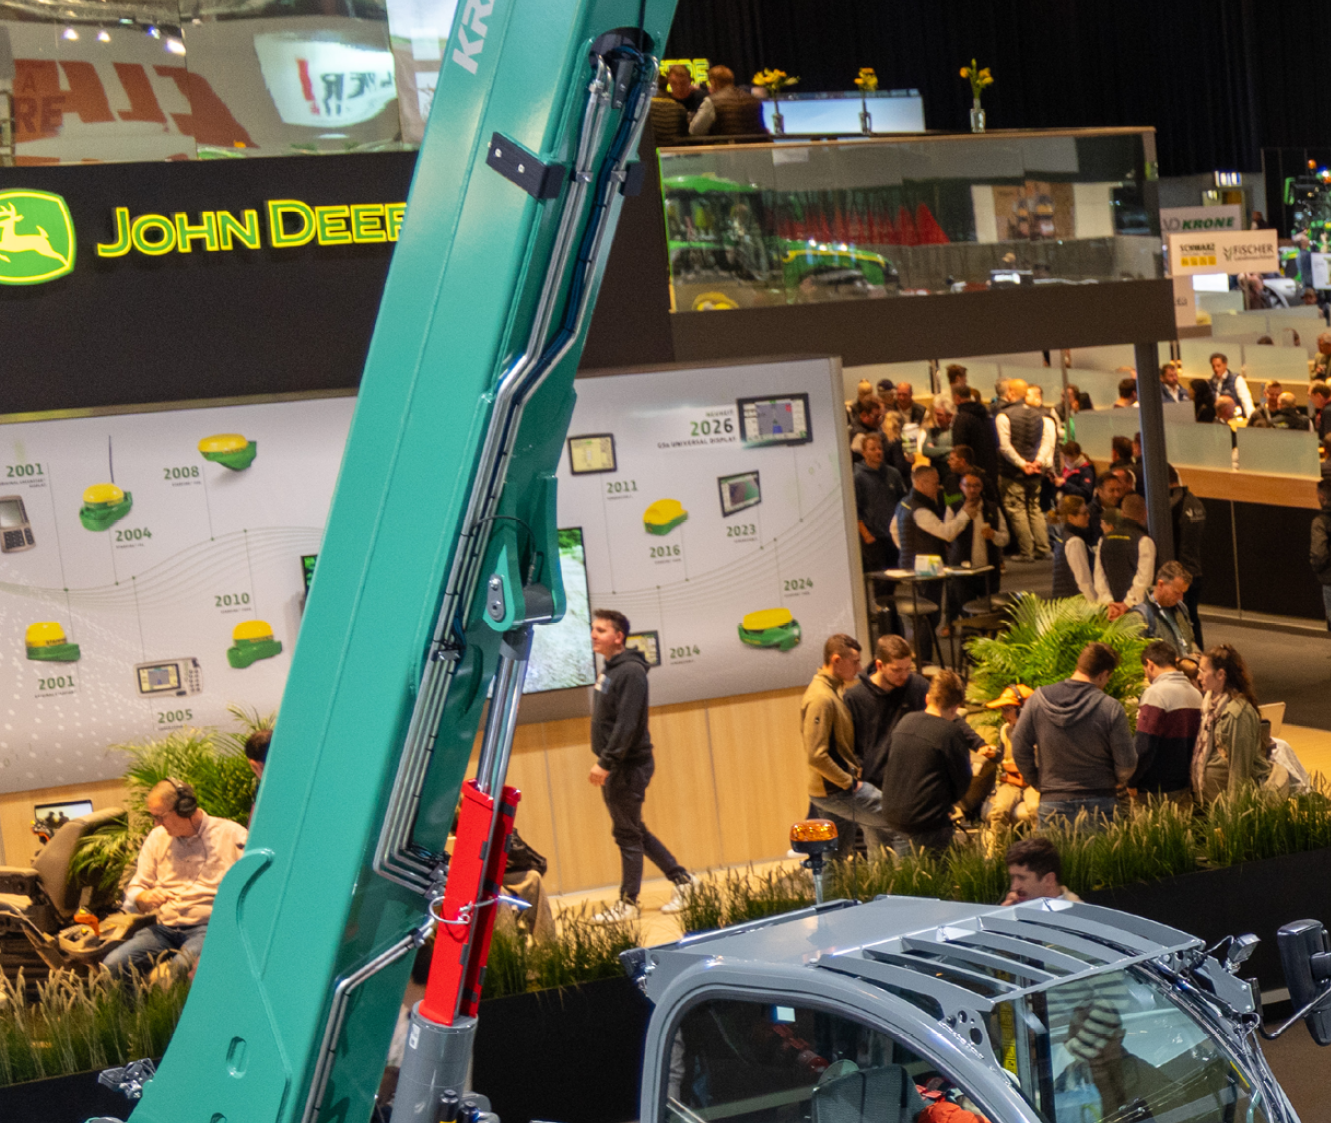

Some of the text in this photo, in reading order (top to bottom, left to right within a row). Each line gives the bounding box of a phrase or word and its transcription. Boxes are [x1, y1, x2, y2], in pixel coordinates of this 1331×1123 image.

[451, 0, 495, 75] KR
[97, 198, 407, 259] JOHN DEE
[1181, 216, 1236, 231] KRONE
[1233, 243, 1275, 255] FISCHER
[690, 418, 734, 437] 2026
[671, 438, 708, 448] UNIVERSAL
[708, 436, 737, 446] DISPLAY
[5, 463, 44, 478] 2001
[163, 465, 200, 480] 2008
[606, 480, 638, 494] 2011
[115, 528, 153, 542] 2004
[726, 524, 756, 537] 2023
[650, 545, 681, 559] 2016
[783, 577, 814, 591] 2024
[214, 592, 250, 608] 2010
[669, 645, 700, 659] 2014
[38, 675, 76, 691] 2001
[157, 709, 194, 724] 2005
